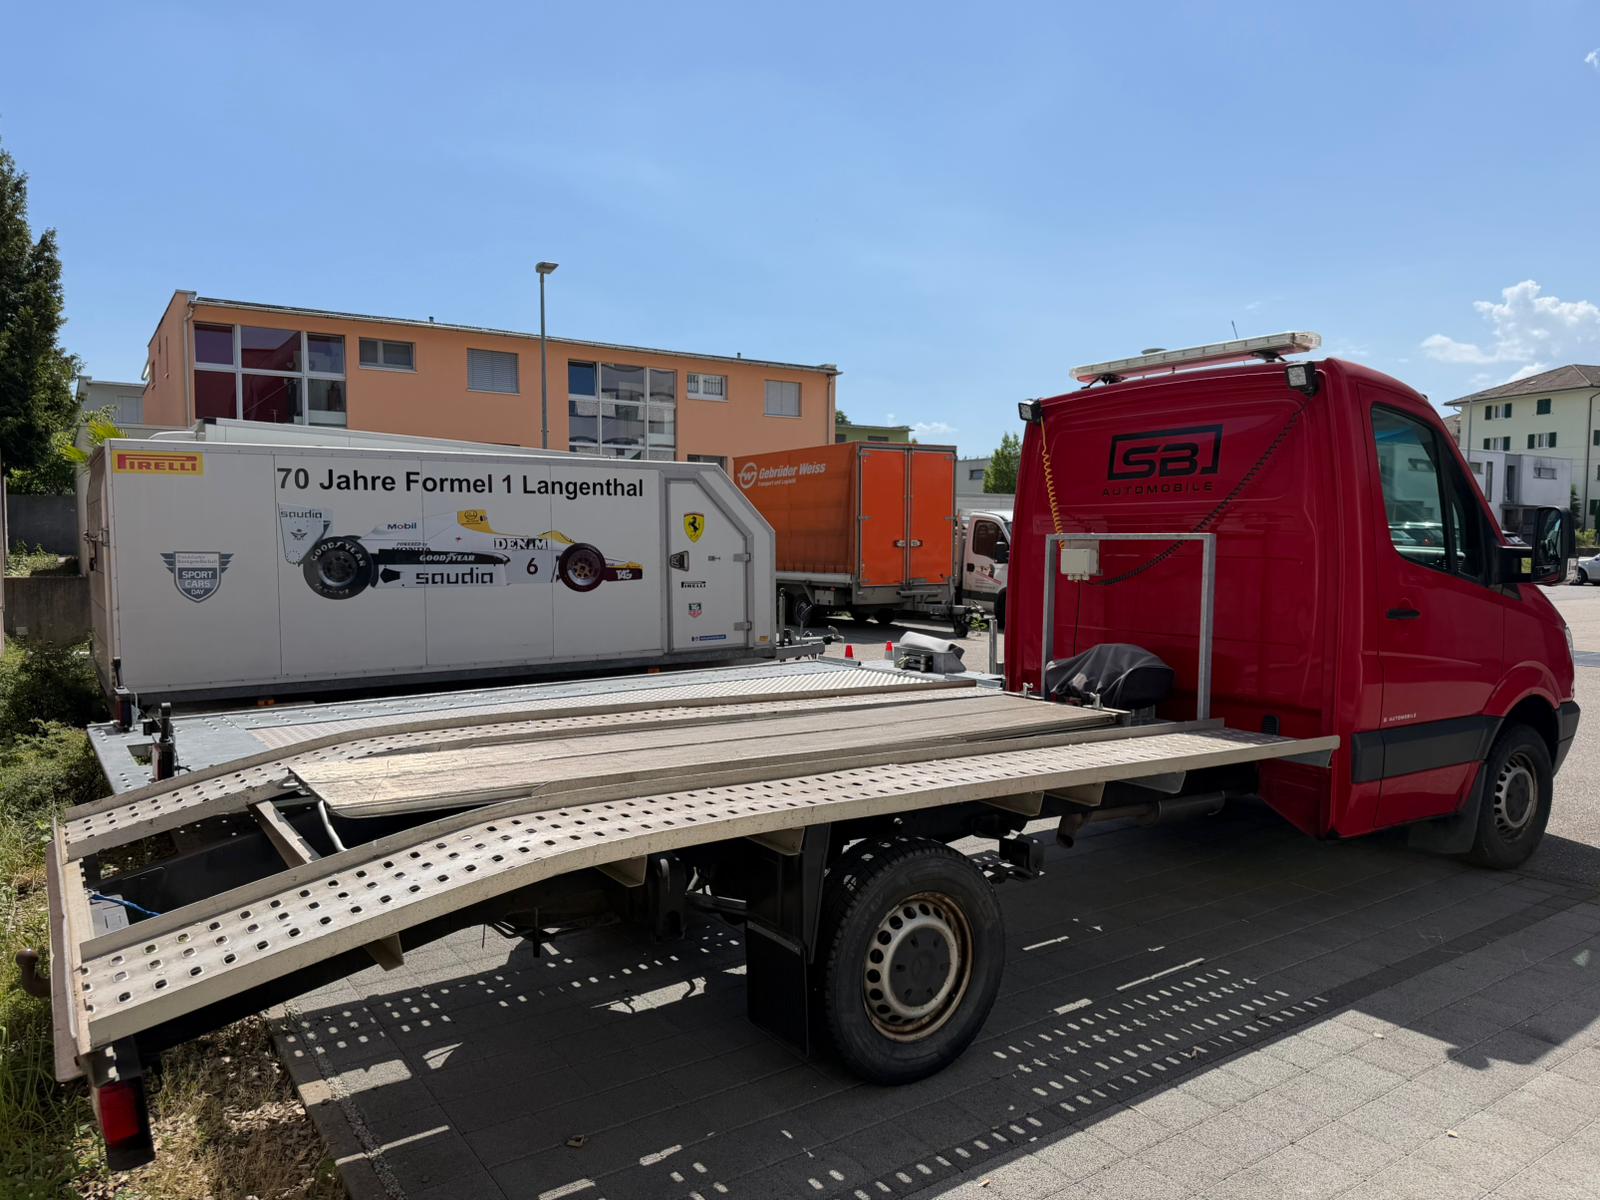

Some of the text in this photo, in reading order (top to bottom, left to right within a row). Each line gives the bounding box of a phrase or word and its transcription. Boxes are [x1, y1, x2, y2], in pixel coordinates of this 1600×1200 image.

[117, 454, 197, 471] PIRELLI
[759, 462, 826, 480] Gebrüder Weiss
[277, 467, 643, 500] 70 Jahre Formel 1 Langenthal
[1103, 481, 1213, 497] AUTOMOBILE
[280, 509, 323, 519] saudia
[387, 522, 417, 530] Mobil
[419, 552, 476, 563] GOODYEAR
[527, 557, 539, 575] 6
[182, 570, 214, 579] SPORT
[416, 567, 494, 585] saudia
[185, 580, 211, 588] CARS
